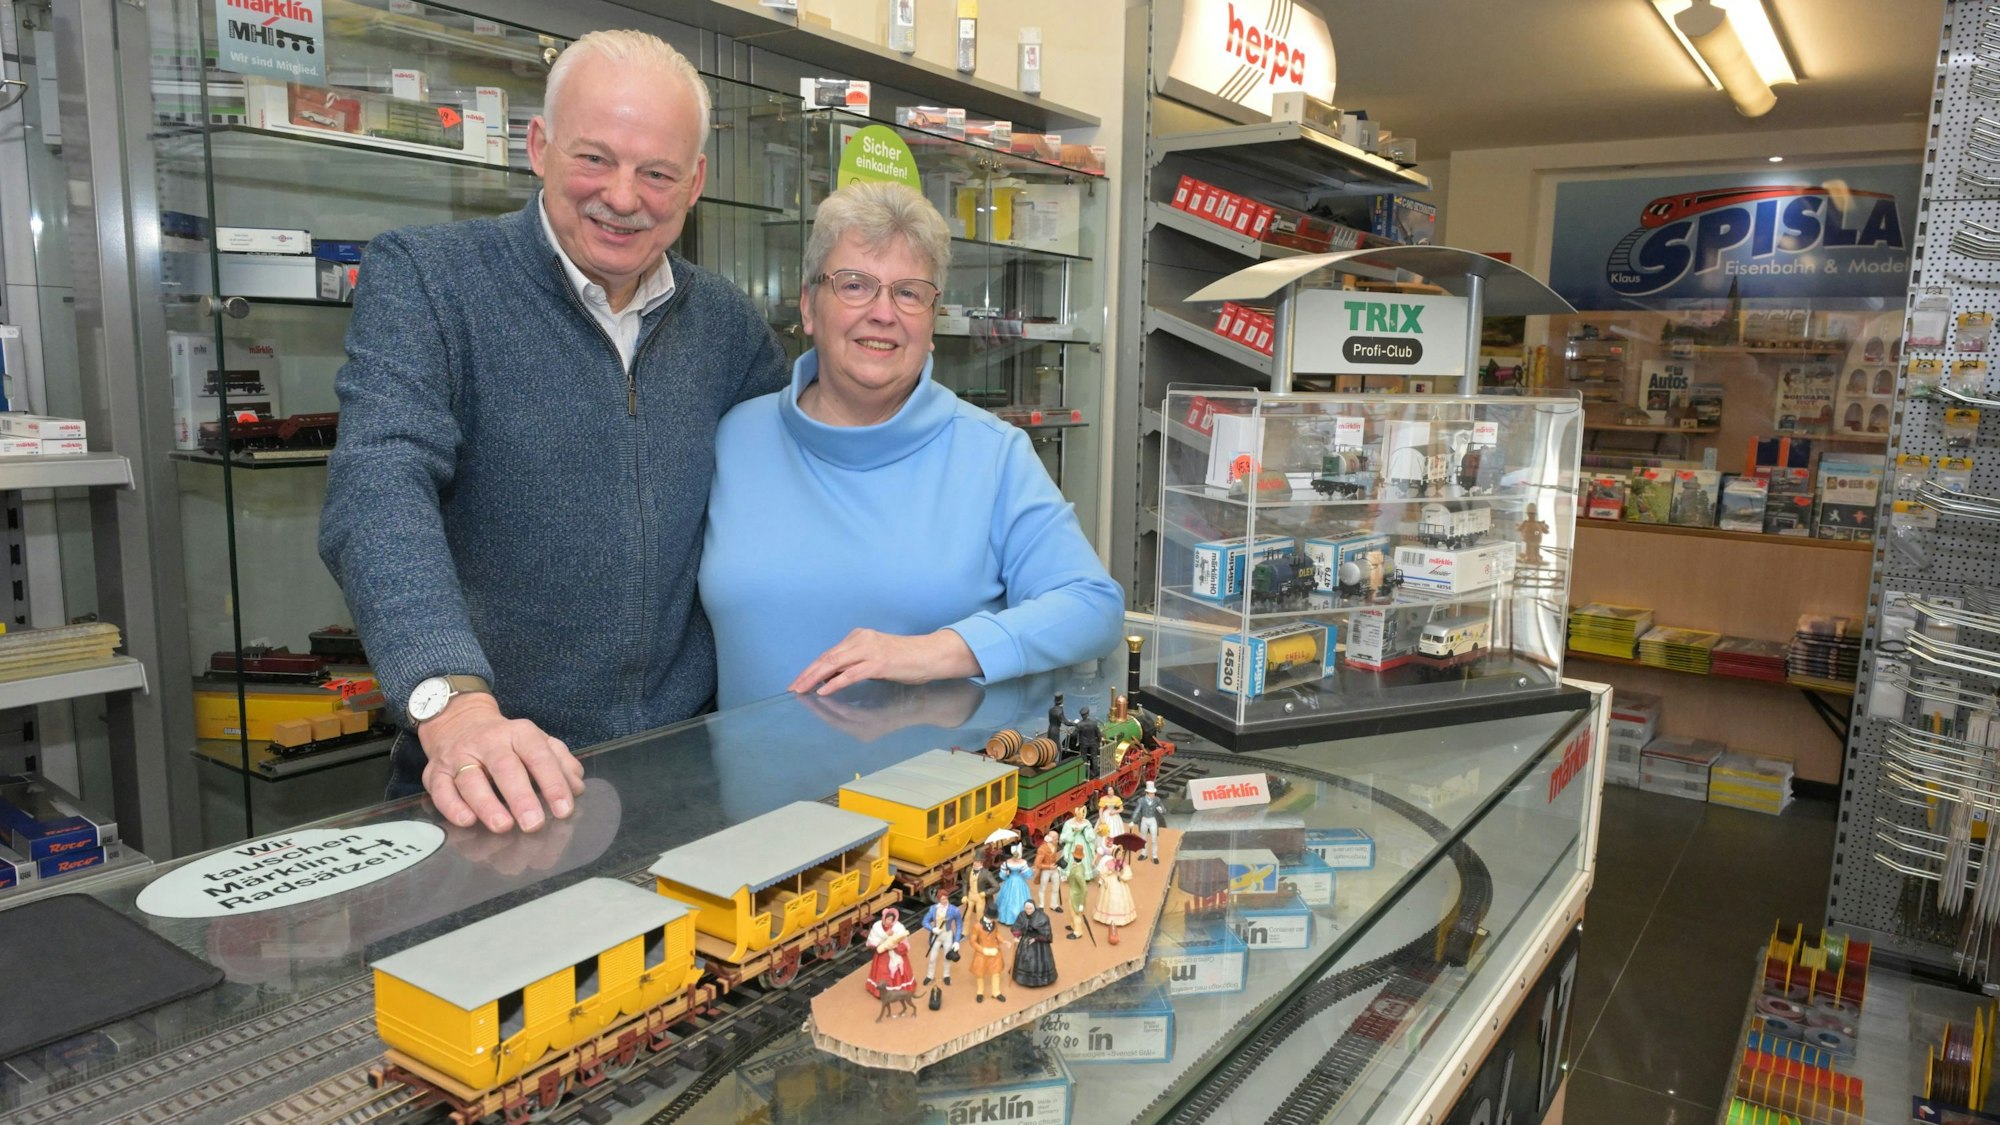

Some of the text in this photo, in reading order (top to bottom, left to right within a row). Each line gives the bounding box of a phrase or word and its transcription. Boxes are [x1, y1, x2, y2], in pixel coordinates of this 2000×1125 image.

[1226, 2, 1305, 85] herpa
[230, 51, 319, 76] Wir sind Mitglied.
[862, 136, 902, 161] Sicher
[855, 154, 908, 180] einkaufen!
[1635, 194, 1906, 284] SPISLA
[1610, 272, 1641, 284] Klaus
[1724, 258, 1816, 275] Eisenbahn
[1824, 261, 1838, 274] &
[1343, 301, 1426, 334] TRIX
[1353, 343, 1413, 358] Profi-Club
[1648, 373, 1688, 389] Autos
[1428, 557, 1453, 566] märklin
[1223, 647, 1235, 686] 4530
[1254, 643, 1264, 694] märklin
[1202, 782, 1259, 801] märklin
[49, 839, 92, 854] Roco
[202, 834, 363, 882] tauschen
[234, 836, 295, 857] Wir
[58, 856, 99, 872] Roco
[202, 855, 340, 897] Märklin
[216, 844, 423, 910] Radsätze!!!
[1040, 1014, 1070, 1032] Retro
[946, 1094, 1034, 1125] ärklin
